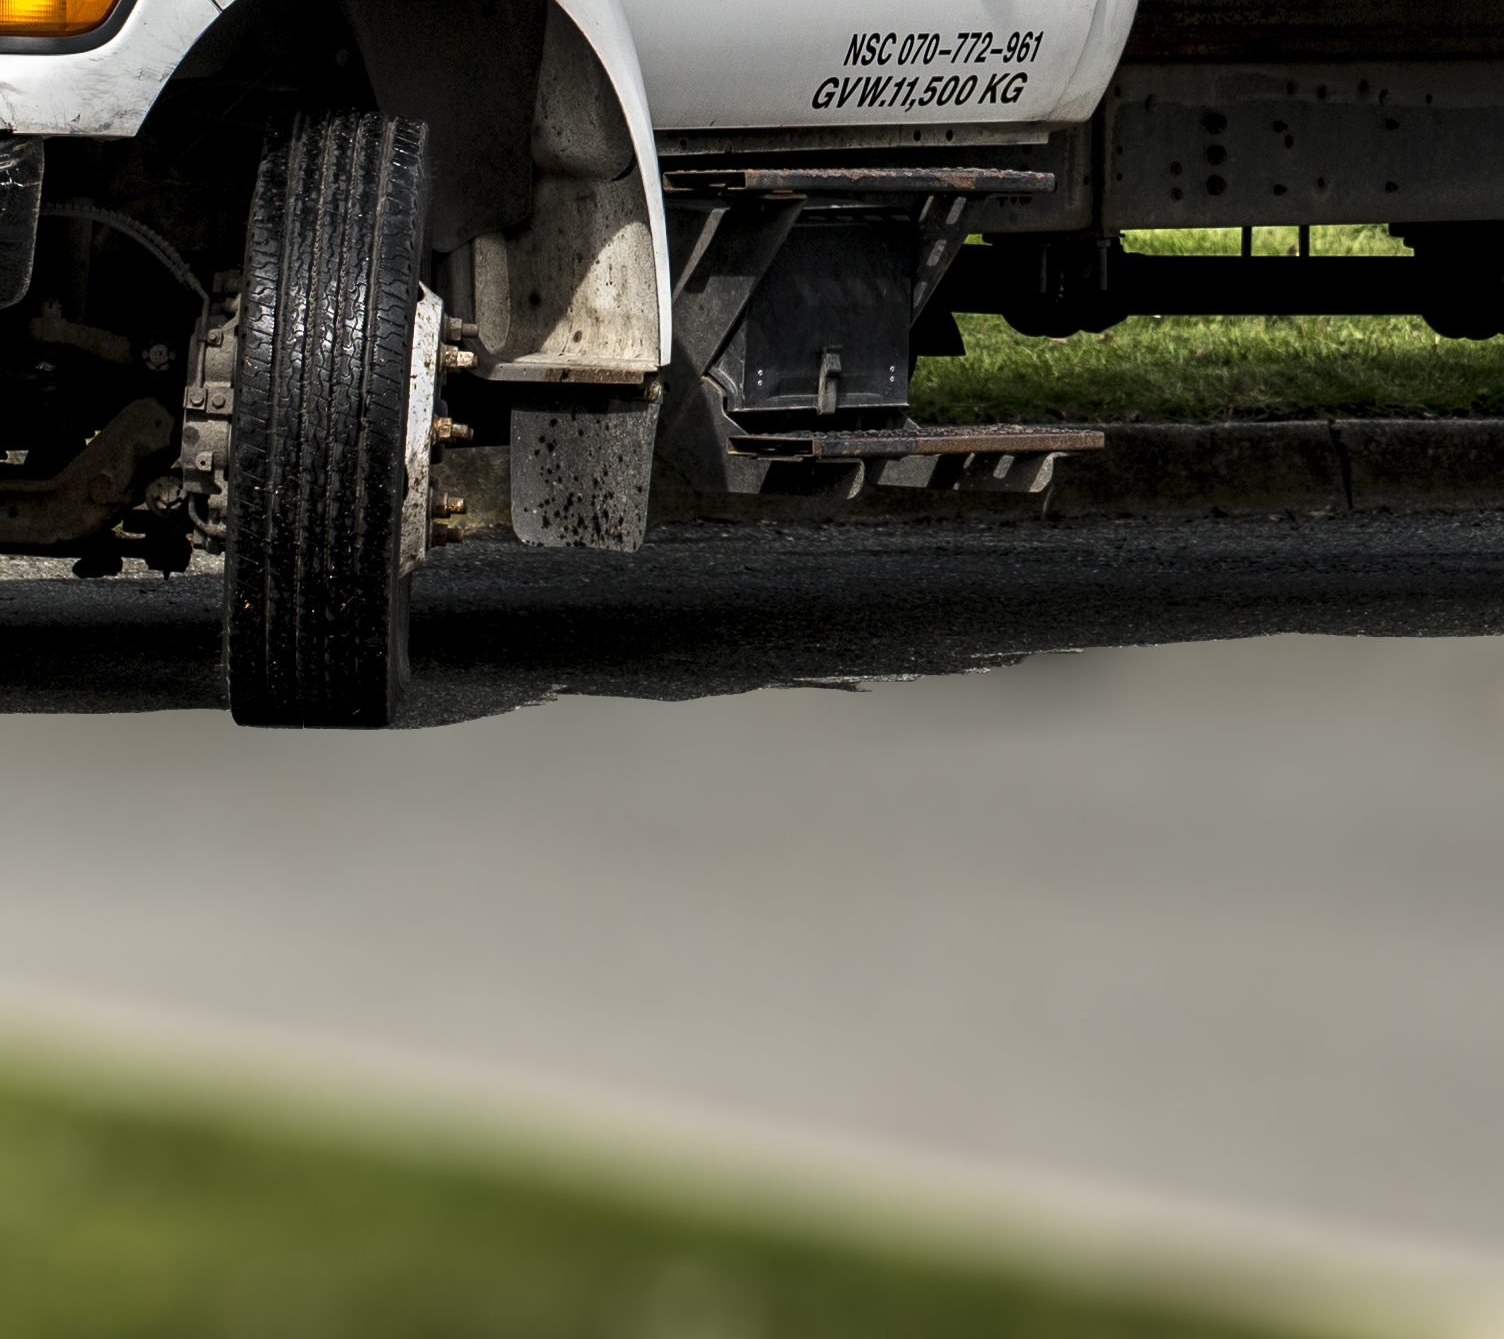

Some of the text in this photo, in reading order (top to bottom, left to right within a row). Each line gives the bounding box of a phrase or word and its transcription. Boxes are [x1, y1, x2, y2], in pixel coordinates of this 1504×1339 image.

[843, 31, 1044, 66] NSC 070-772-961
[978, 72, 1028, 105] KG
